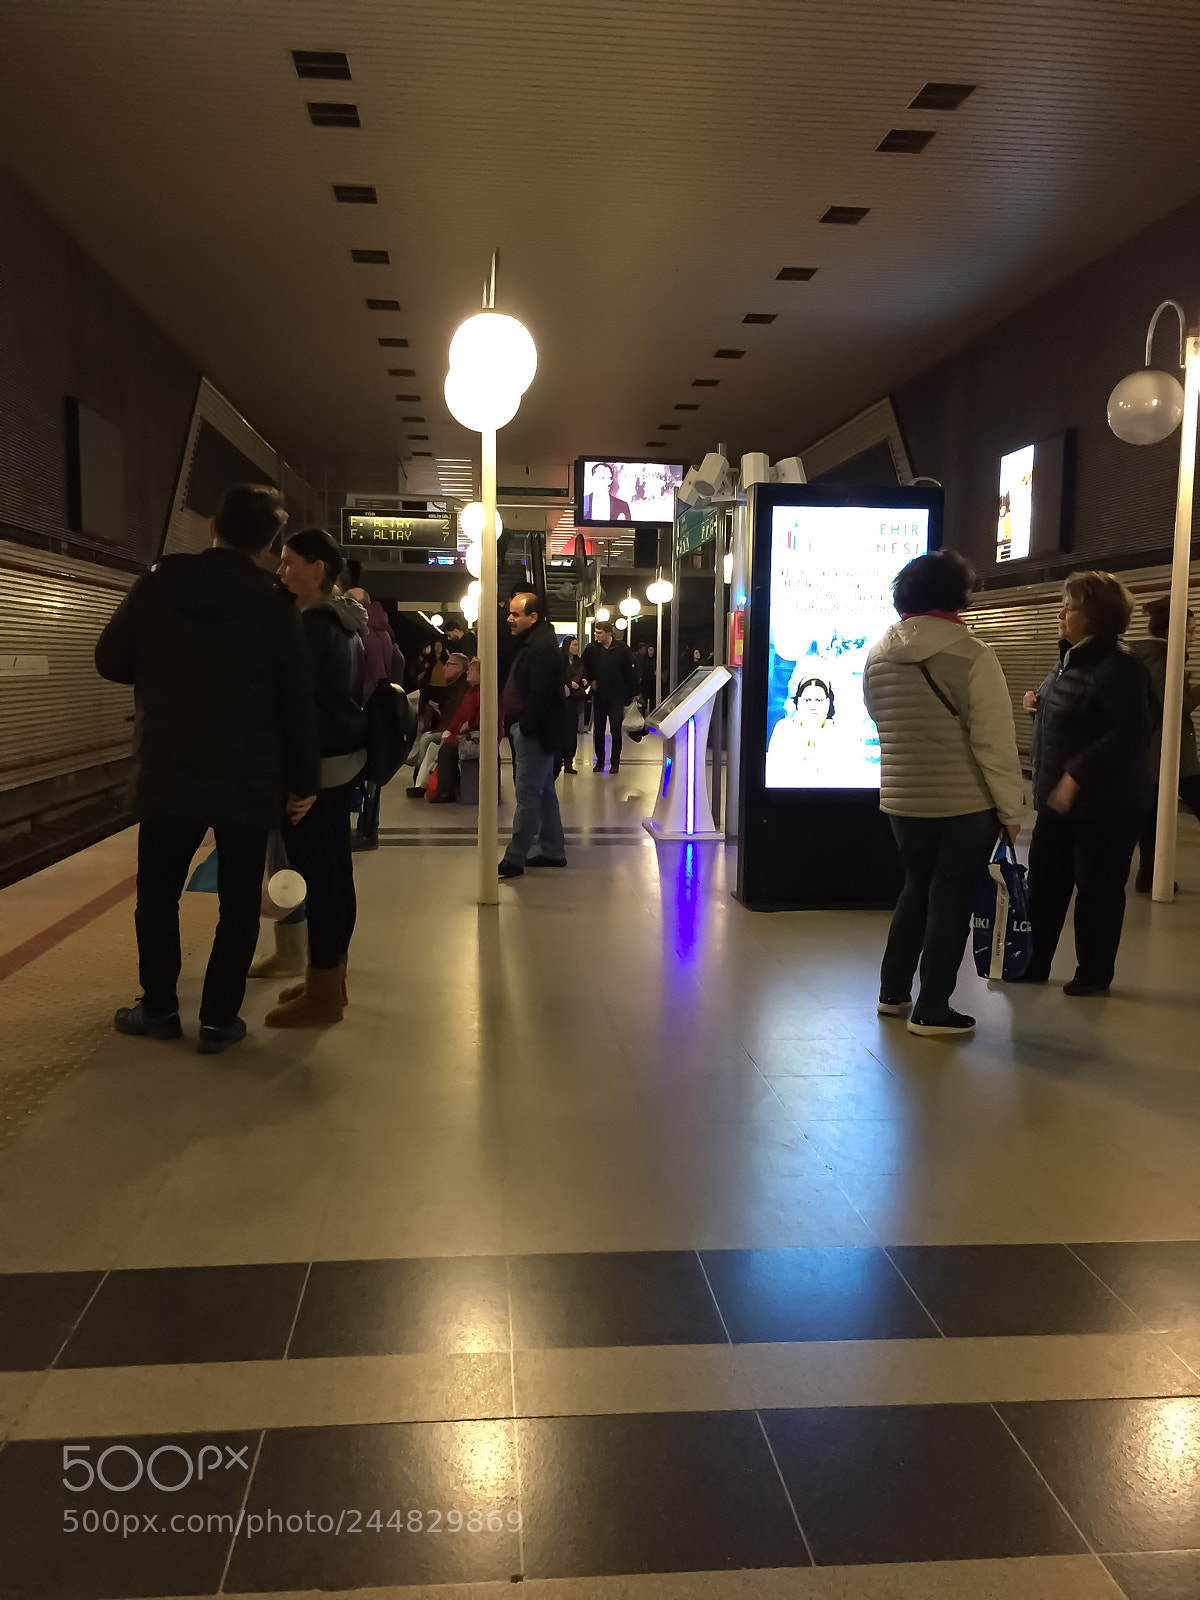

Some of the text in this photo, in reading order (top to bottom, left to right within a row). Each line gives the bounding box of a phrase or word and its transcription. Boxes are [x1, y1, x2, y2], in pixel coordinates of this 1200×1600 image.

[350, 516, 450, 530] F. ALTAY 2
[350, 528, 450, 542] F. ALTAY 7
